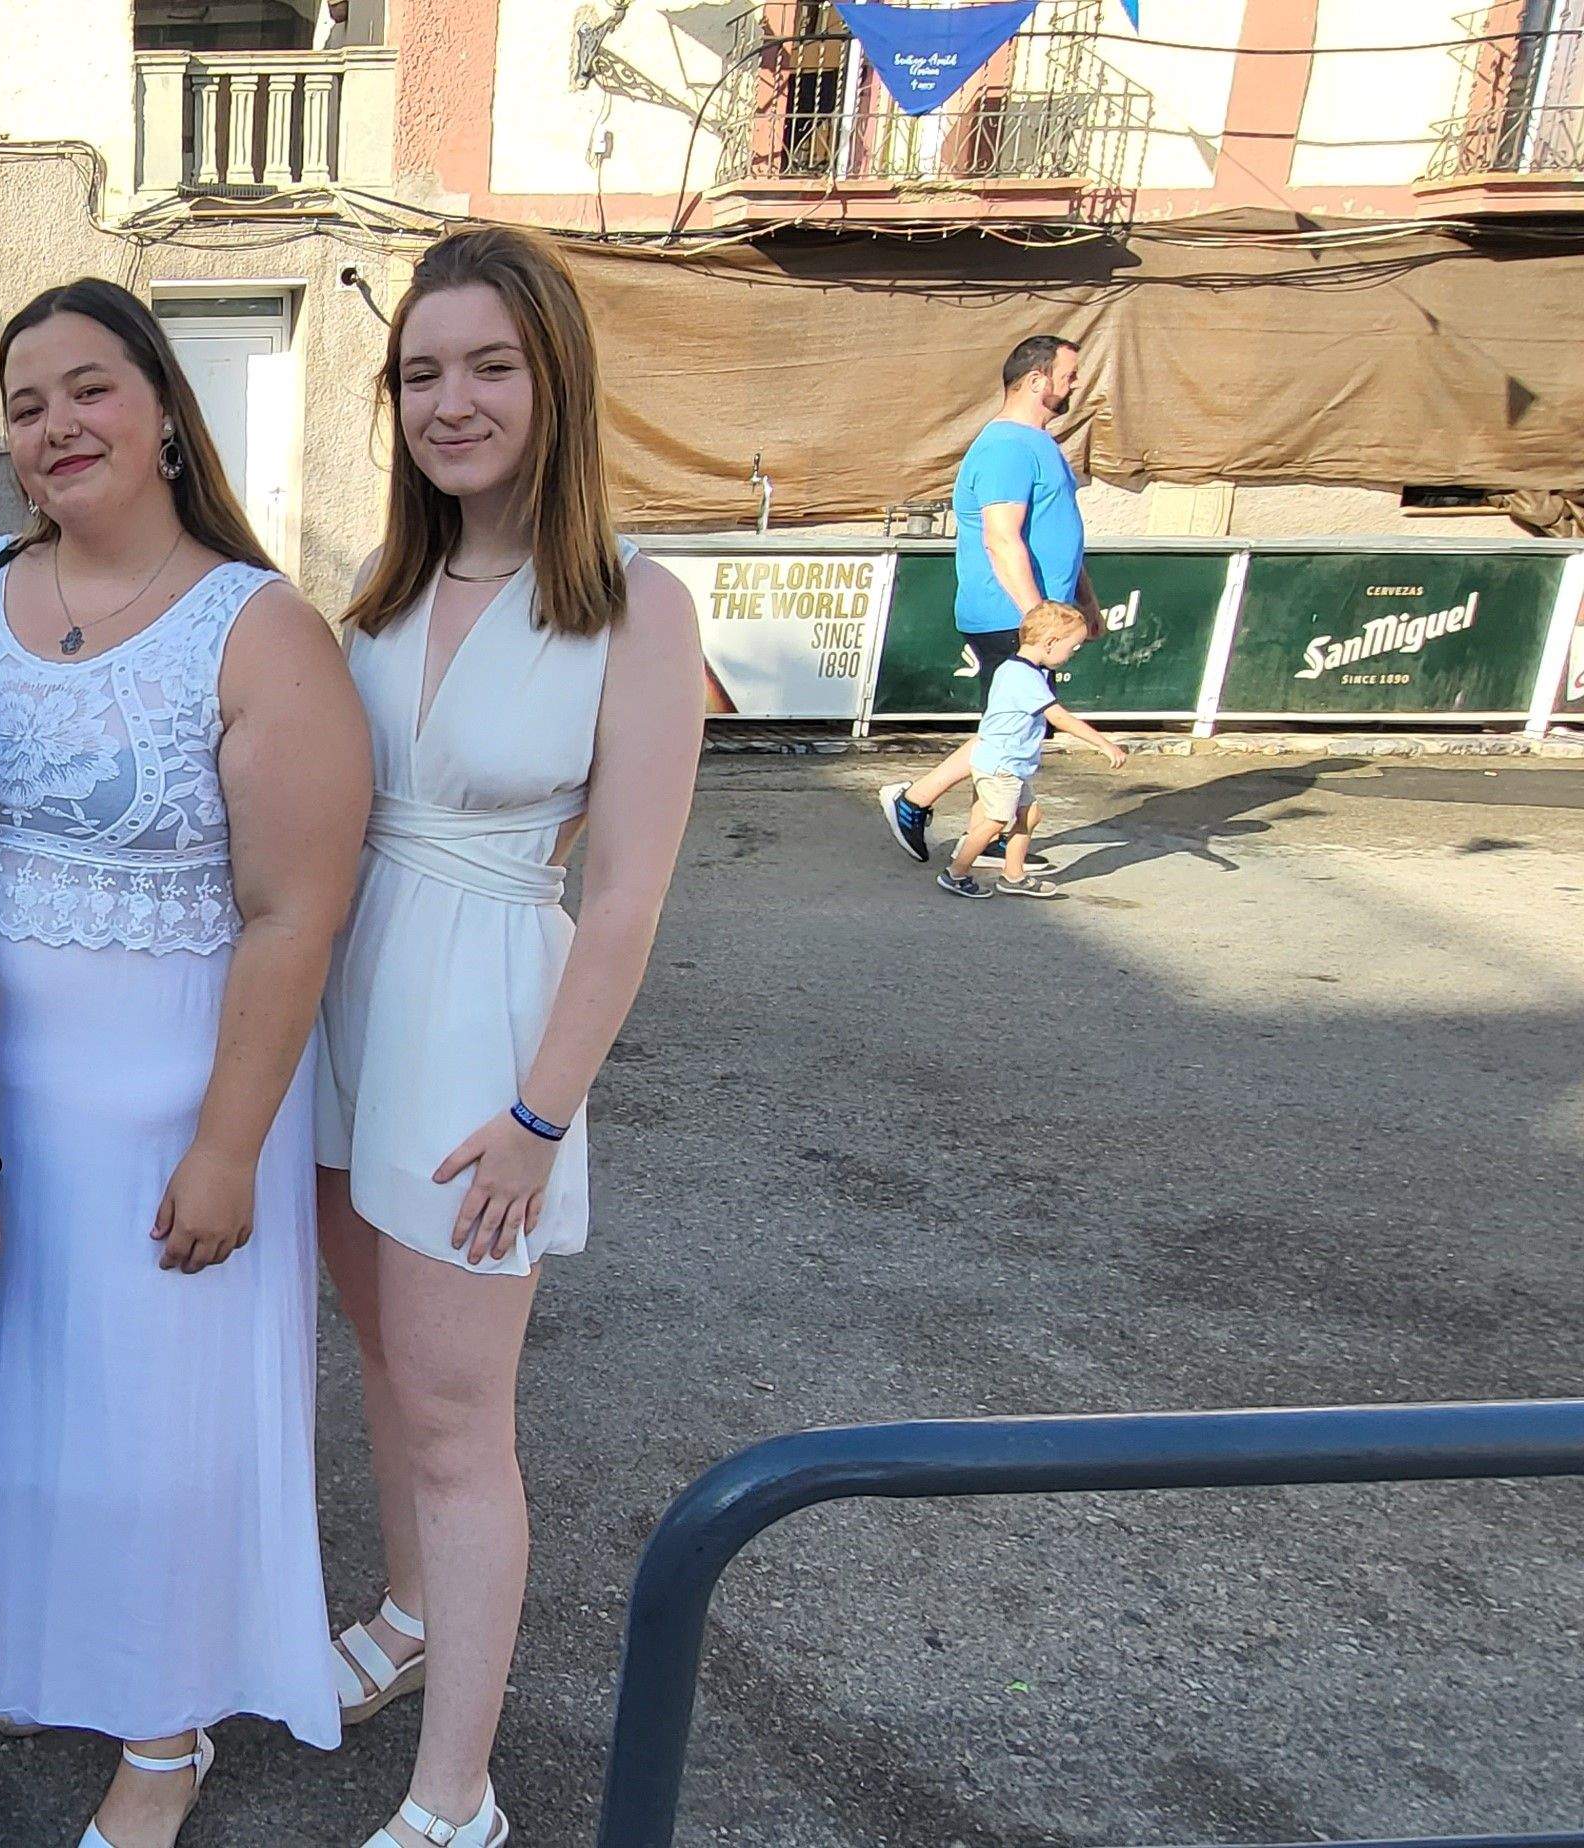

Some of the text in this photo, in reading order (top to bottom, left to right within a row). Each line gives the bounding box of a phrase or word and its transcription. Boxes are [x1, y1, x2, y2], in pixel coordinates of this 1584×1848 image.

[714, 562, 874, 590] EXPLORING
[1366, 586, 1424, 596] CERVEZAS
[710, 592, 869, 620] THE WORLD
[811, 622, 865, 649] SINCE
[818, 651, 861, 679] 1890
[1341, 674, 1409, 684] SINCE 1890
